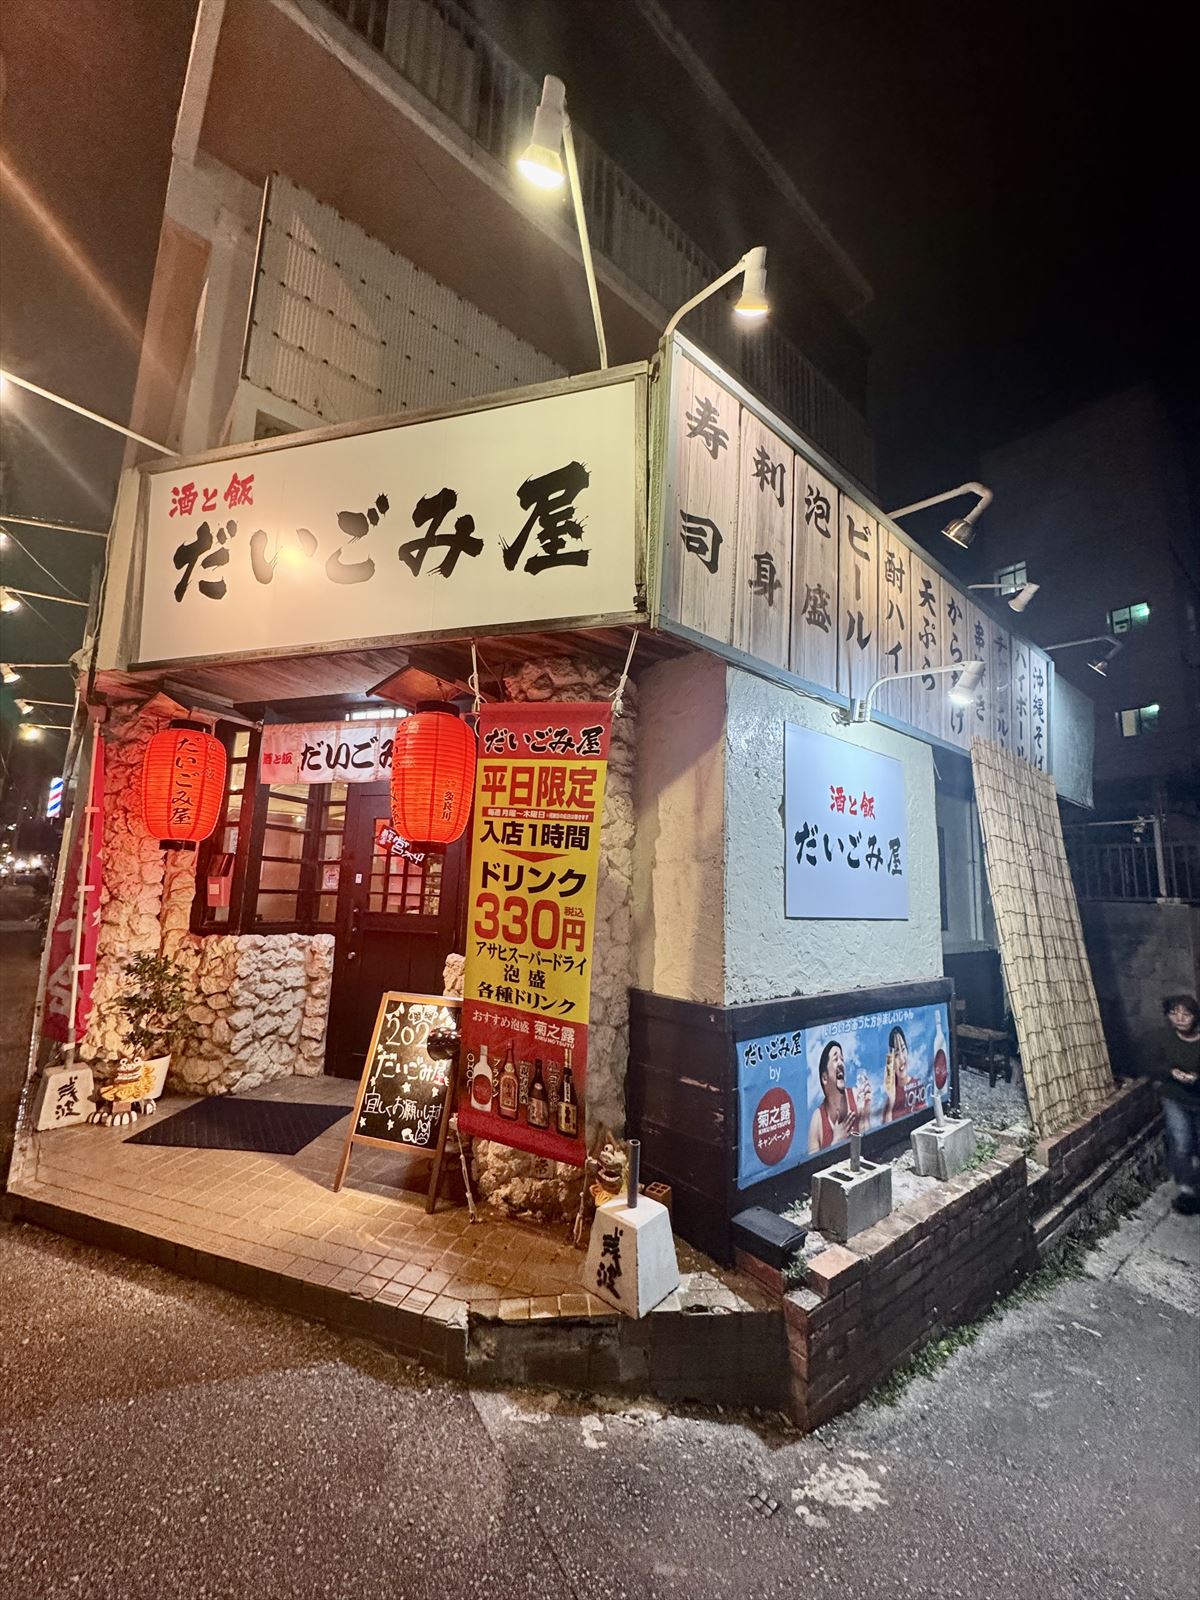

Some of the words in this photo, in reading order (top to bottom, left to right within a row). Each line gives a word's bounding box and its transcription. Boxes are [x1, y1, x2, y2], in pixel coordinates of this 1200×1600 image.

[168, 472, 255, 518] 酒と飯
[680, 396, 730, 575] 寿司
[172, 460, 591, 603] だいごみ屋
[748, 445, 787, 608] 刺身
[802, 484, 832, 634] 泡盛
[846, 514, 872, 651] ビール
[884, 550, 905, 674] 酎ハイ
[918, 577, 937, 691] 天ぷら
[947, 597, 963, 735] からげ
[484, 725, 605, 756] だいごみ屋
[168, 737, 202, 824] だいごみ屋
[481, 765, 597, 808] 平日限定
[829, 785, 876, 820] 酒と飯
[480, 821, 590, 850] 入店1時間
[794, 821, 903, 876] だいごみ屋
[481, 861, 586, 897] ドリンク
[564, 906, 584, 917] 税込
[475, 941, 587, 976] アサヒスーパードライ
[477, 981, 576, 1015] 各種ドリンク
[534, 1020, 575, 1044] 菊之露
[744, 1031, 802, 1067] だいごみ屋
[769, 1066, 780, 1081] by
[757, 1102, 790, 1128] 菊之露
